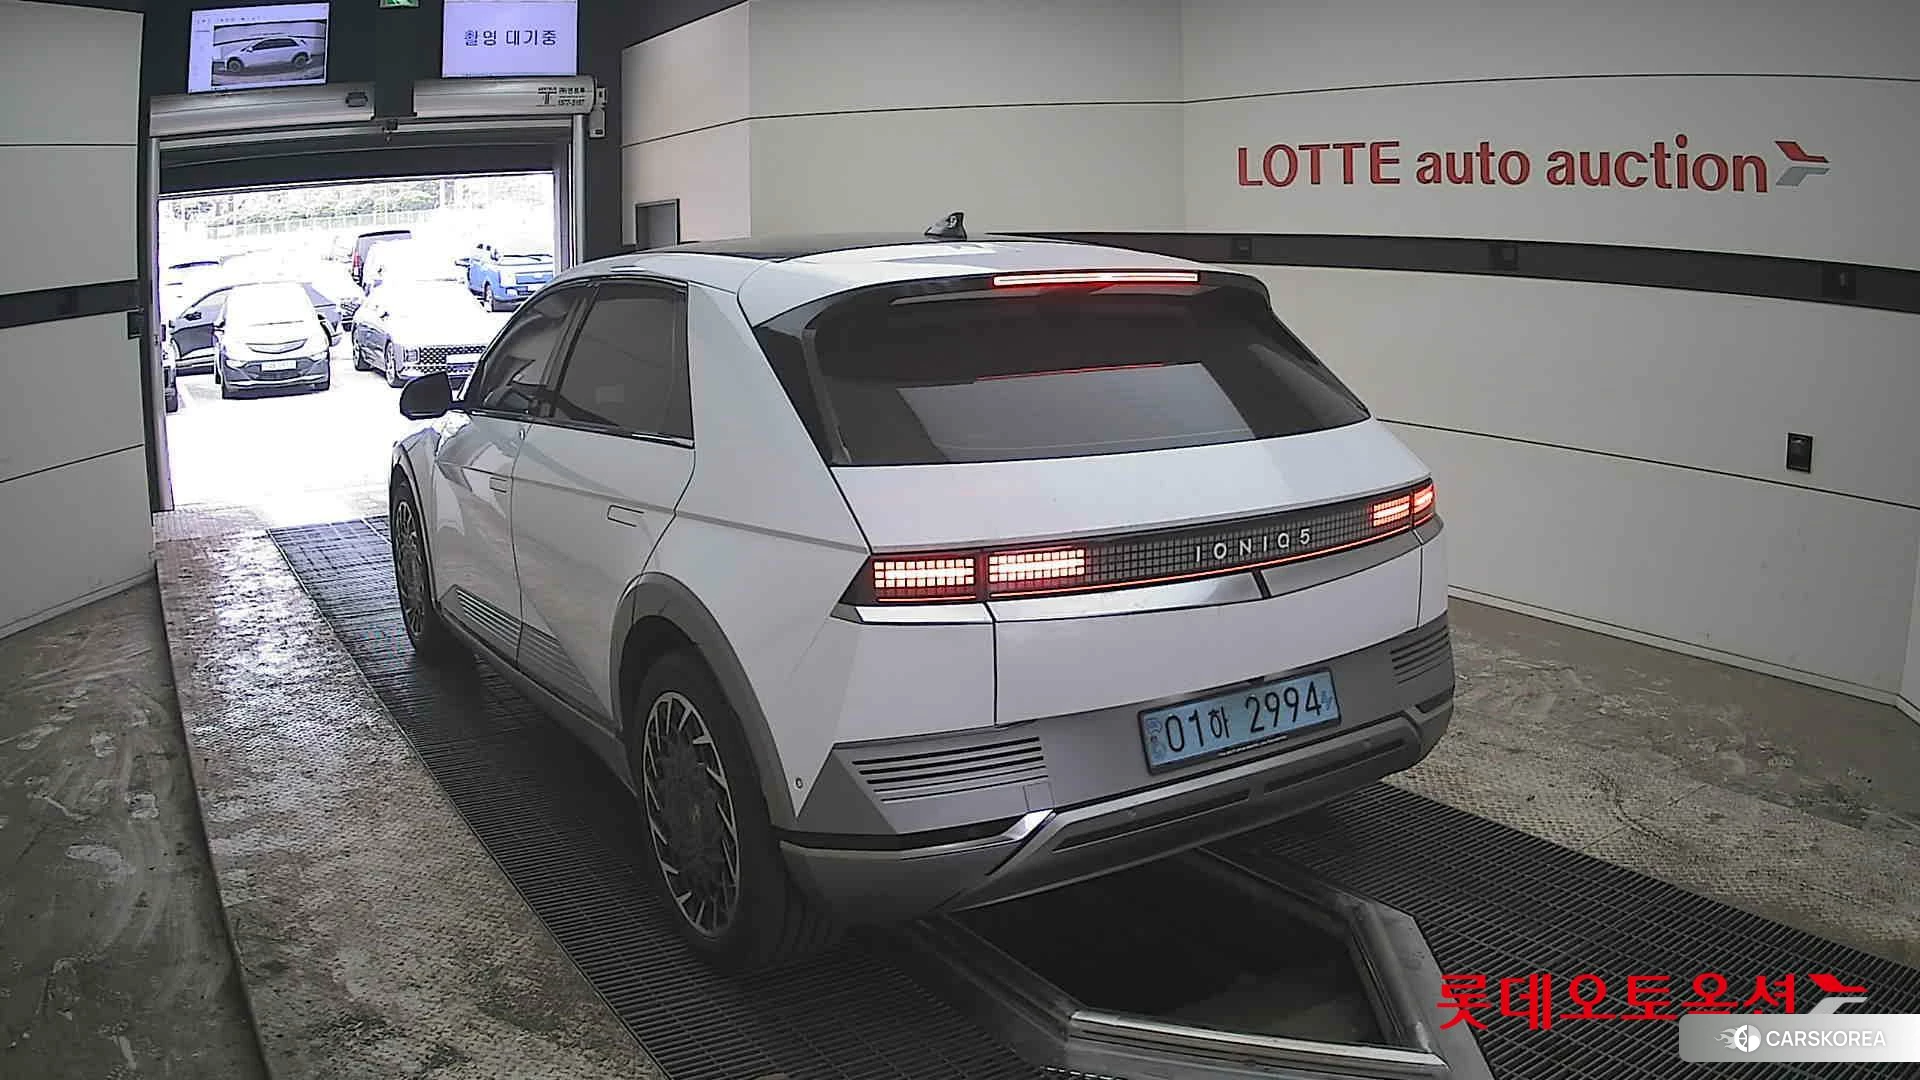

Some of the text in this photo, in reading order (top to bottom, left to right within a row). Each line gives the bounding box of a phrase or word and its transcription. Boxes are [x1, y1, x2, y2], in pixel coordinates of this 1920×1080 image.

[505, 30, 557, 46] 대기중
[1238, 134, 1768, 193] LOTTE auto auction
[1196, 533, 1290, 562] IONIQ
[1165, 706, 1230, 752] 01하
[1246, 681, 1321, 733] 2994
